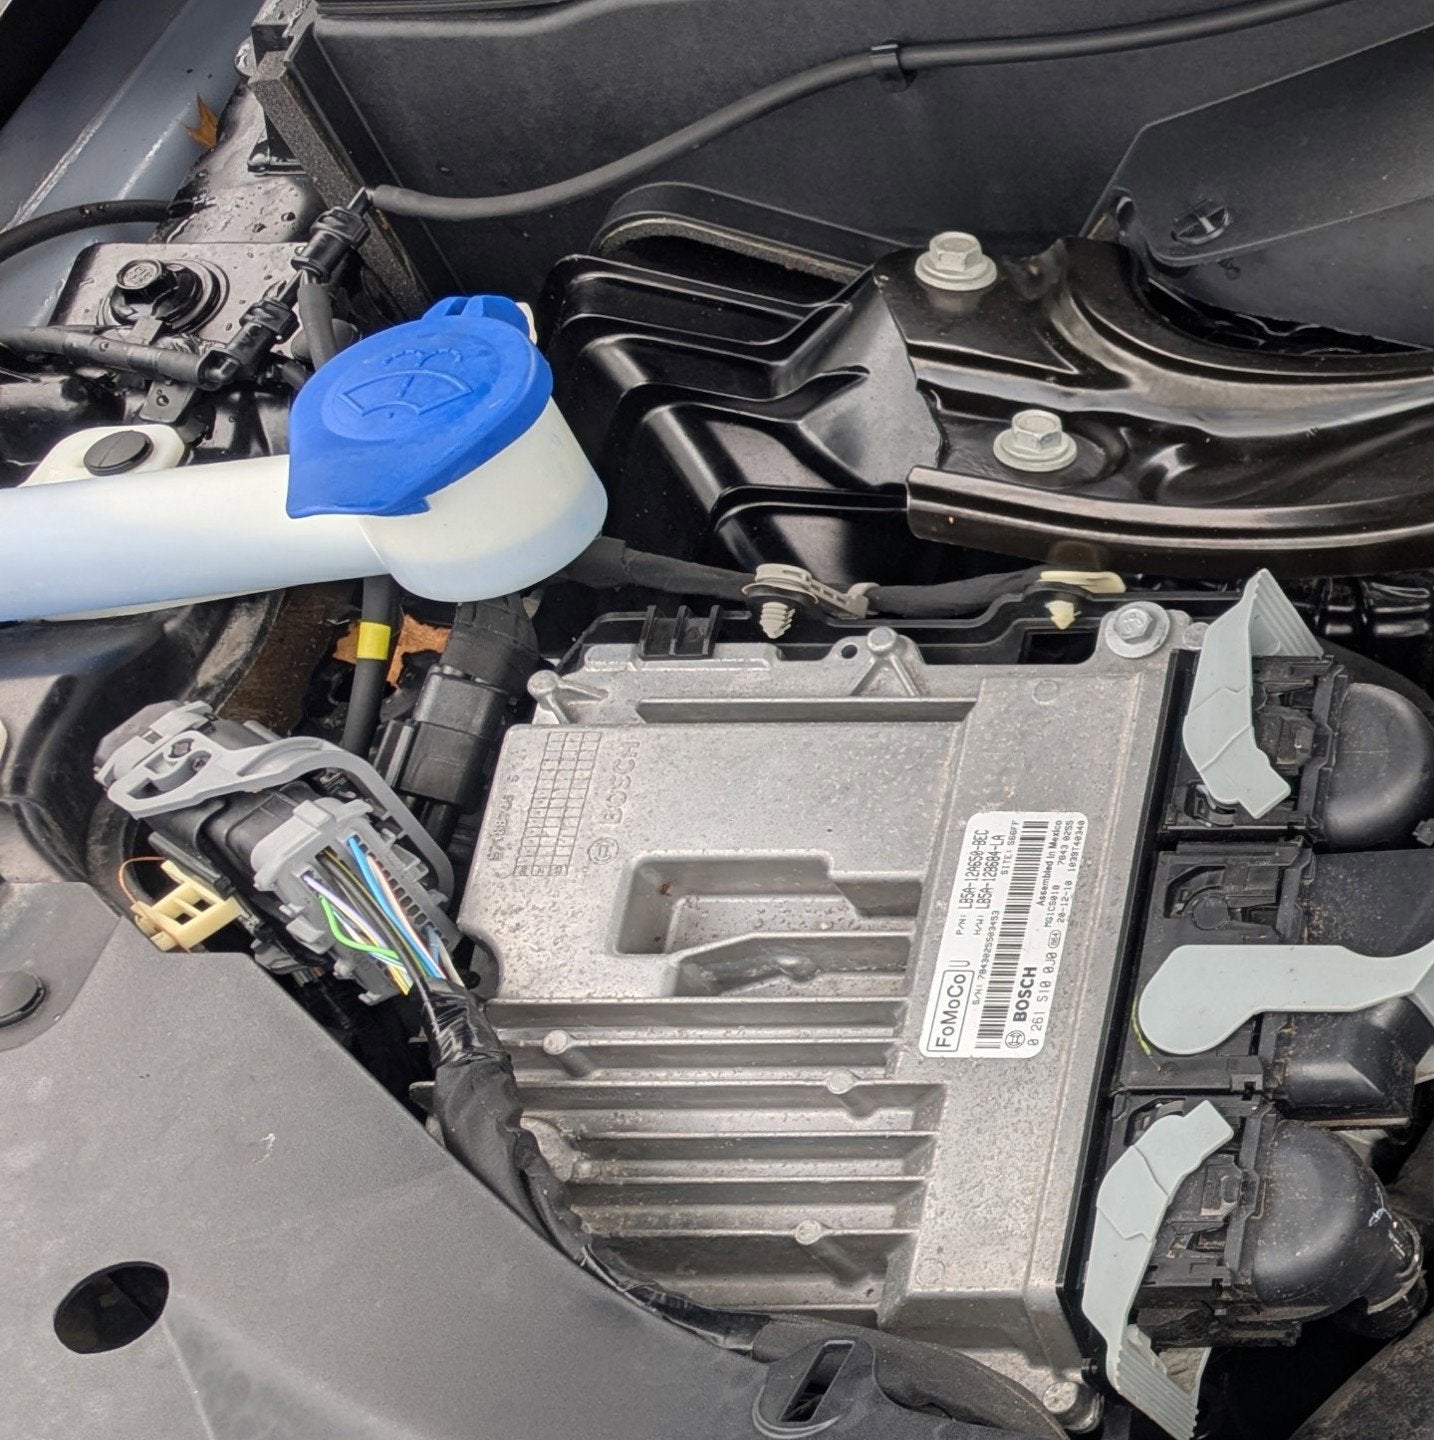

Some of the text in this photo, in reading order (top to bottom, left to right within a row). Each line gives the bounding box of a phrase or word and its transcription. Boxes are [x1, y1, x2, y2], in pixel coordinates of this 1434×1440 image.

[604, 740, 640, 826] BOSCH
[1036, 861, 1054, 906] Assembled
[1048, 819, 1062, 848] Mexico
[955, 913, 967, 935] P/N:
[1056, 880, 1072, 922] 20-12-10
[934, 973, 966, 1047] FoMoCo
[1012, 966, 1036, 1021] BOSCH
[1030, 1010, 1045, 1031] 261
